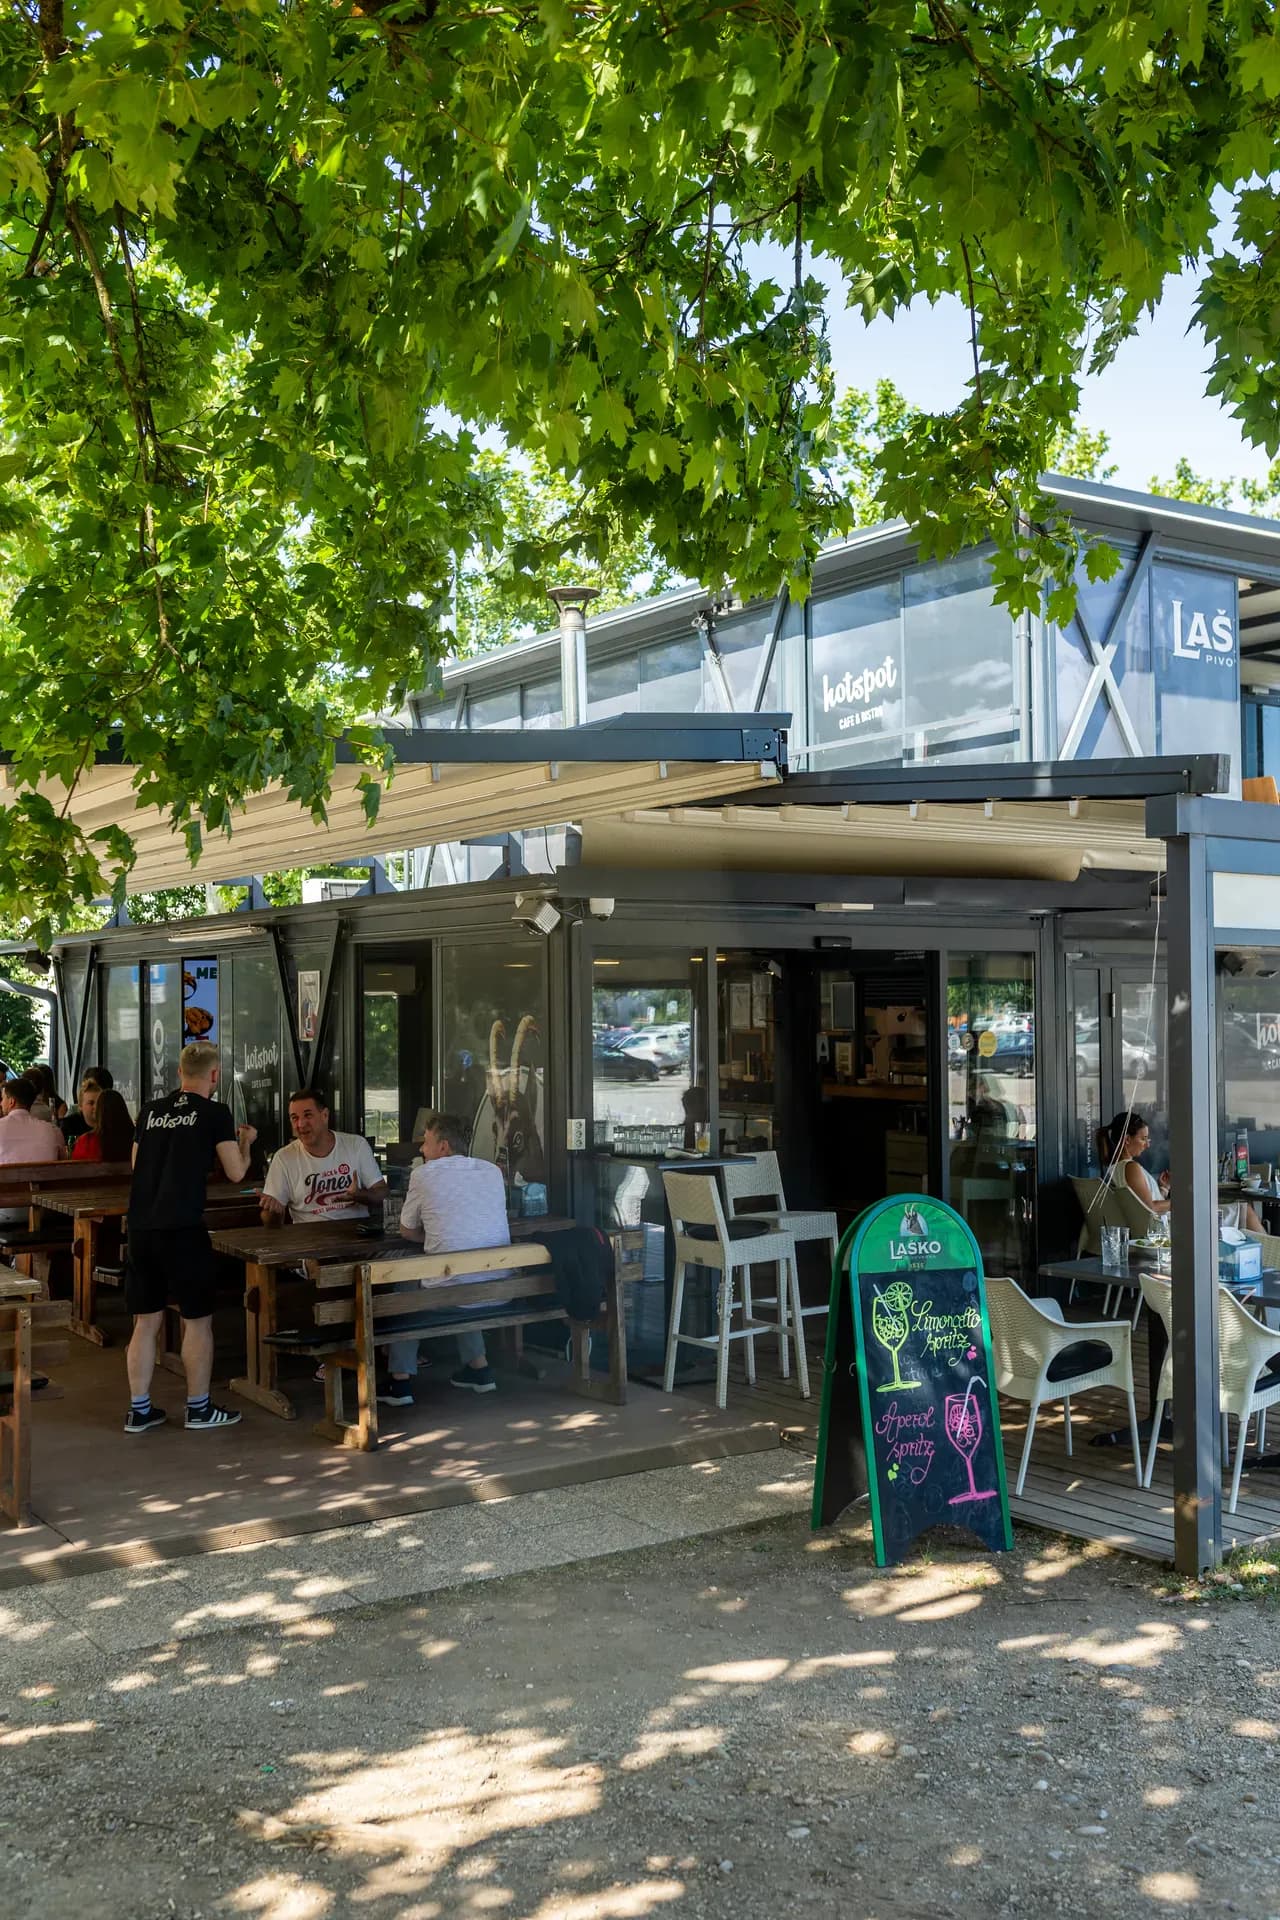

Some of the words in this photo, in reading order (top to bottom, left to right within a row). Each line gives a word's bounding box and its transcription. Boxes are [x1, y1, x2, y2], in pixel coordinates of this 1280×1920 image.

[1172, 600, 1234, 660] LAŠ
[1206, 654, 1236, 668] PIVO
[823, 655, 897, 712] hotspot
[196, 967, 218, 980] ME
[244, 1041, 279, 1073] hotspot
[146, 1110, 198, 1130] hotspot
[304, 1173, 353, 1204] Jones
[876, 1401, 936, 1443] Aperol
